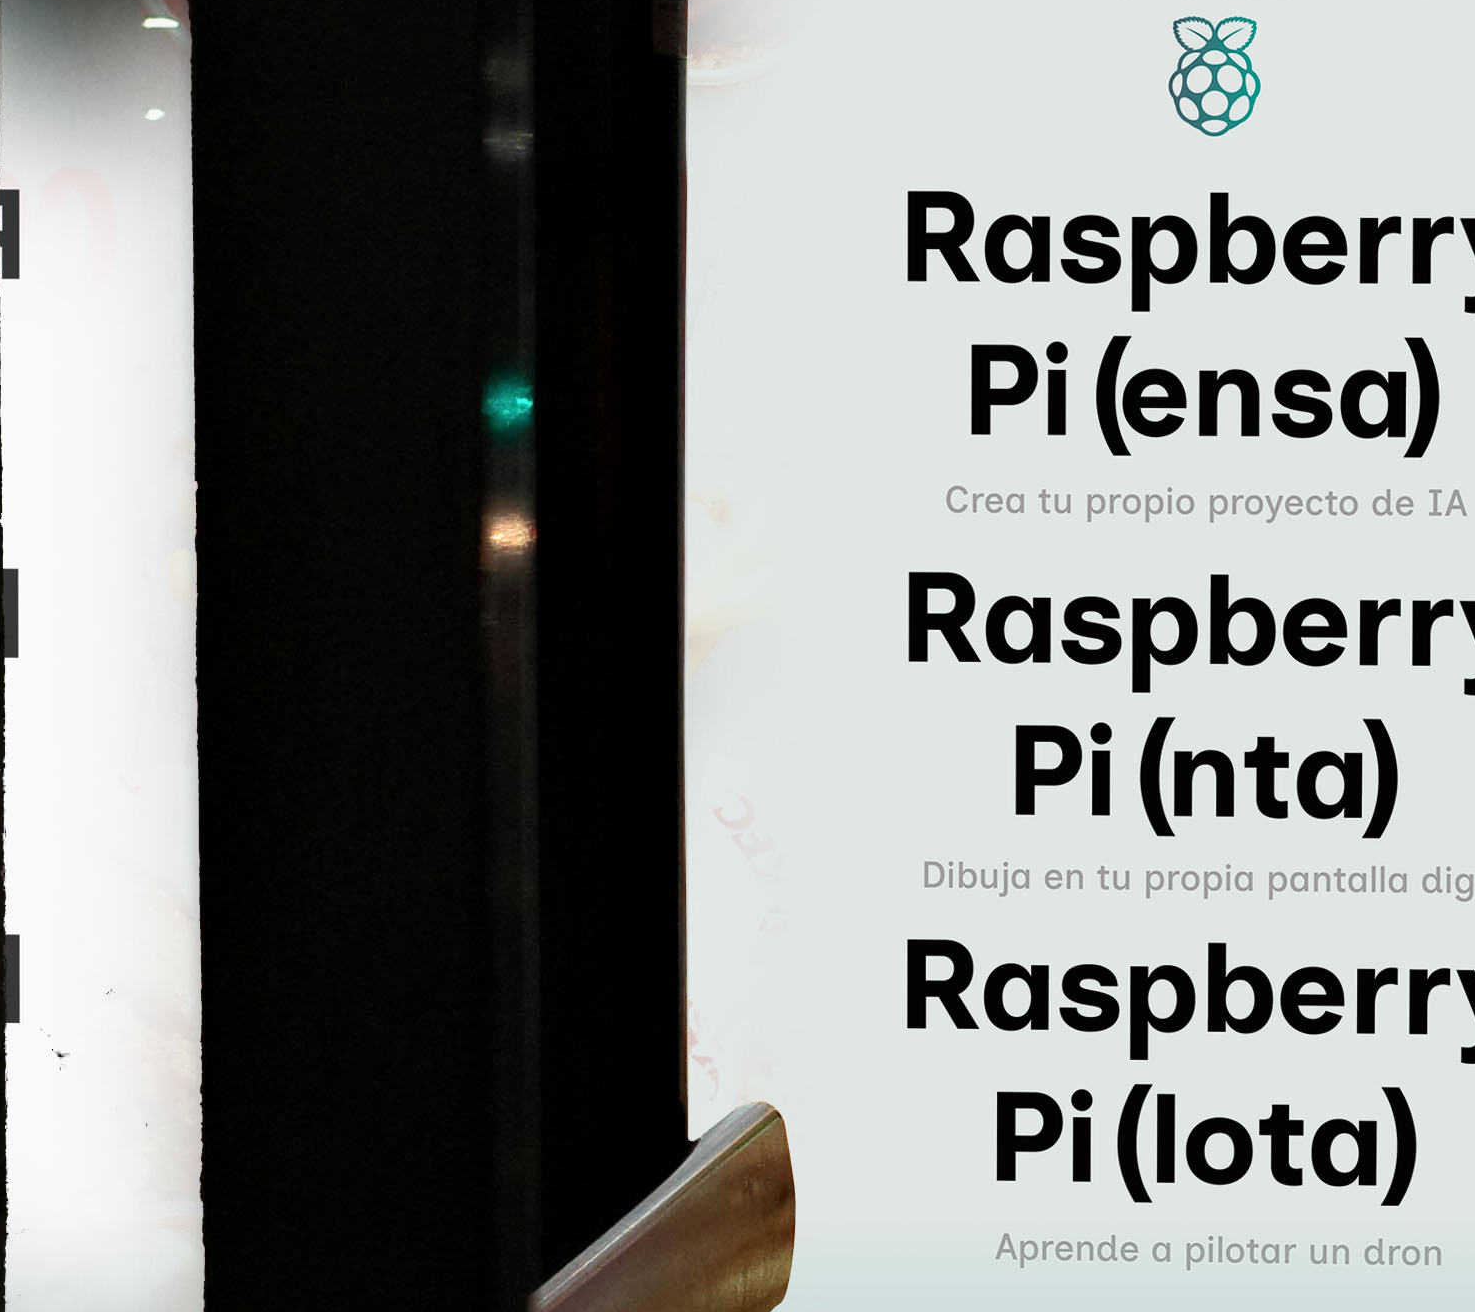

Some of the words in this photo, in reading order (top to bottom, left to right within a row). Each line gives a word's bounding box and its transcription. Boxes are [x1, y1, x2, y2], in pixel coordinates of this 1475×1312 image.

[945, 485, 1025, 514] Crea
[1037, 488, 1072, 515] tu
[1086, 486, 1195, 524] propio
[1209, 490, 1359, 524] proyecto
[1371, 488, 1415, 517] de
[1428, 488, 1468, 517] IA
[923, 860, 1031, 898] Dibuja
[1044, 868, 1084, 891] en
[1096, 865, 1131, 891] tu
[1145, 863, 1254, 901] propia
[1268, 865, 1408, 902] pantalla
[994, 1232, 1140, 1270] Aprende
[1151, 1241, 1172, 1263] a
[1185, 1234, 1298, 1272] pilotar
[1309, 1243, 1351, 1266] un
[1363, 1237, 1442, 1267] dron
